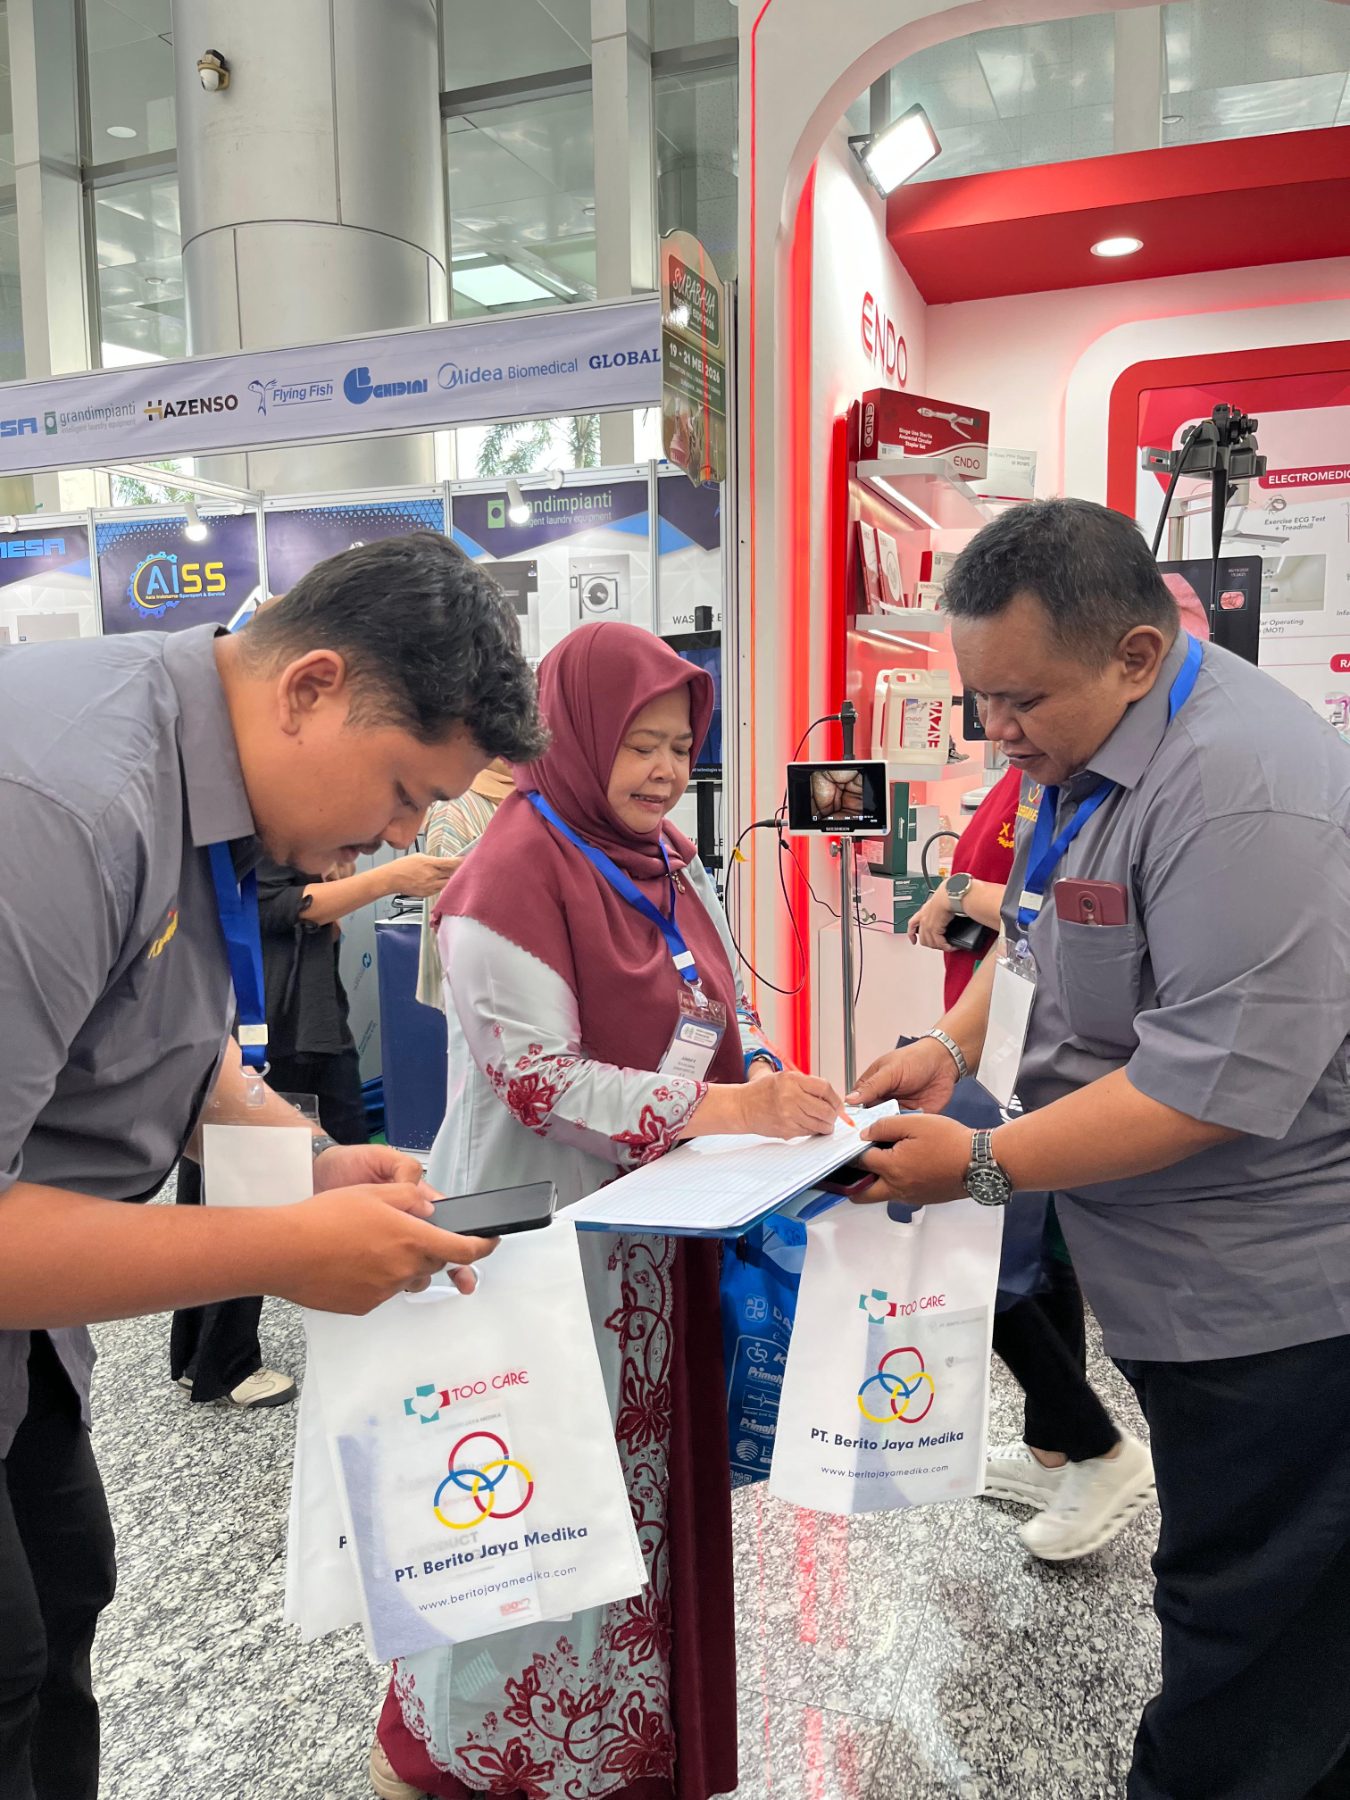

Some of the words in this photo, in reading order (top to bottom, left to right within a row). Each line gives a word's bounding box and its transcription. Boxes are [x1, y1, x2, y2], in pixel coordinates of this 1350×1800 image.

[861, 290, 908, 388] ENDO
[588, 348, 661, 370] GLOBAL
[442, 366, 503, 388] Midea
[508, 358, 578, 379] Biomedical
[704, 364, 720, 384] 2026
[273, 387, 306, 402] Flying
[309, 383, 333, 397] Fish
[60, 401, 136, 427] grandimpianti
[144, 394, 239, 421] HAZENSO
[865, 403, 874, 447] ENDO
[953, 456, 980, 470] ENDO
[524, 490, 612, 514] andimpianti
[546, 514, 573, 525] laundry
[574, 511, 612, 525] equipment
[147, 561, 226, 595] AISS
[1269, 619, 1304, 627] Operating
[899, 1300, 917, 1317] TOO
[919, 1294, 946, 1310] CARE
[452, 1381, 487, 1400] TOO
[491, 1371, 530, 1389] CARE
[810, 1428, 829, 1443] PT.
[834, 1433, 878, 1450] Berito
[882, 1439, 914, 1451] Jaya
[917, 1431, 964, 1448] Medika
[821, 1464, 949, 1479] www.beritojayamedika.com
[394, 1566, 418, 1582] PT.
[423, 1551, 475, 1575] Berito
[479, 1540, 518, 1559] Jaya
[523, 1526, 589, 1548] Medika
[418, 1566, 578, 1611] www.beritojayamedika.com
